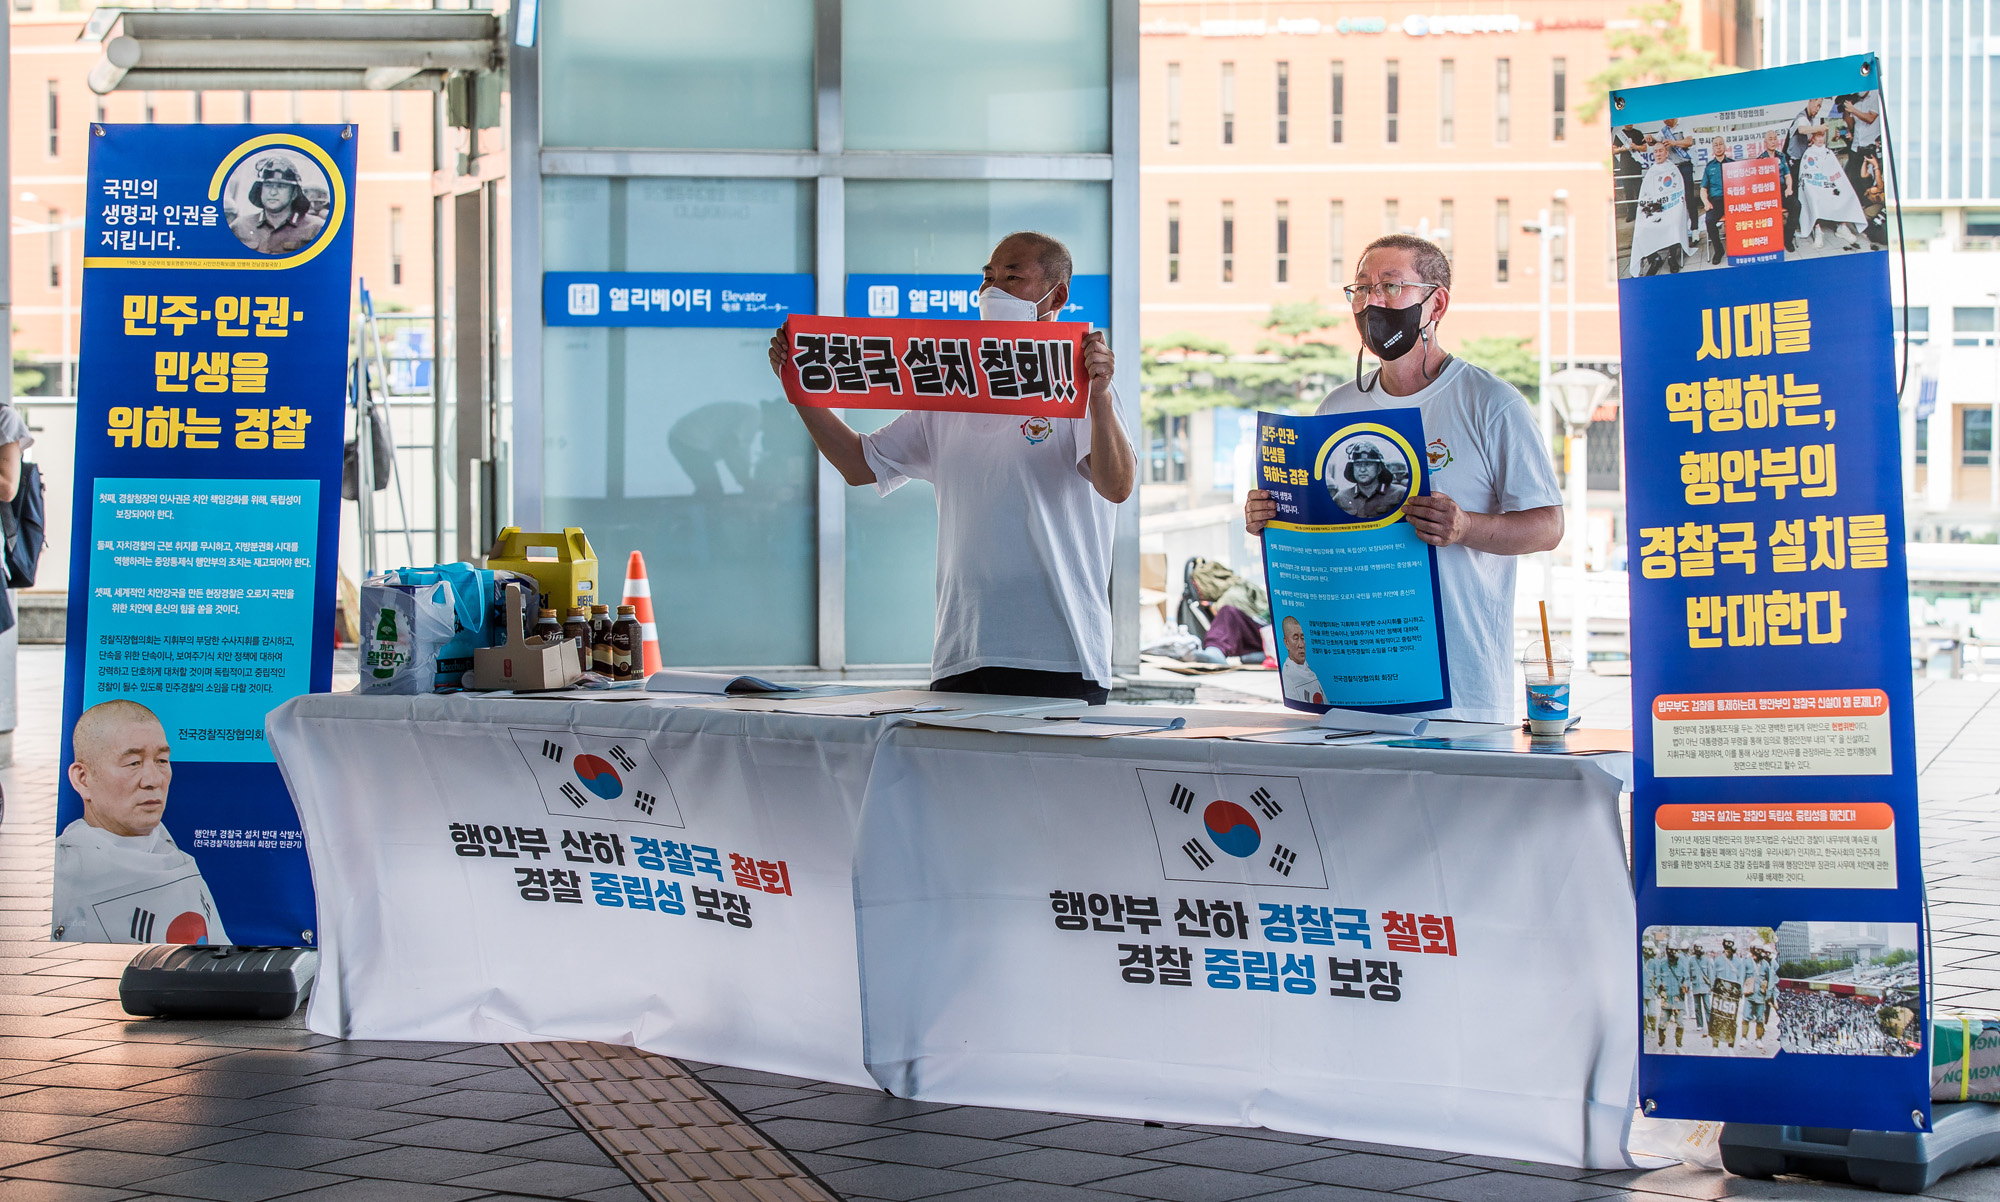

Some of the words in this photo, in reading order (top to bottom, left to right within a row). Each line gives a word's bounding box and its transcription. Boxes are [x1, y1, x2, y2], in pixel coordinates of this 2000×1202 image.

[103, 179, 157, 199] 국민의
[101, 205, 157, 226] 생명과
[164, 205, 219, 227] 인권을
[101, 231, 181, 251] 지킵니다.
[609, 288, 711, 312] 엘리베이터
[722, 290, 767, 302] Elevator
[908, 289, 980, 313] 엘리베
[123, 295, 303, 337] 민주·인권·
[1696, 299, 1811, 361] 시대를
[155, 352, 269, 393] 민생을
[794, 333, 903, 395] 경찰국
[902, 337, 979, 397] 설치
[979, 337, 1078, 404] 철회!!
[1665, 374, 1836, 433] 역행하는,
[107, 407, 222, 449] 위하는
[235, 407, 311, 449] 경찰
[1262, 446, 1285, 463] 민생을
[1263, 466, 1288, 483] 위하는
[1289, 469, 1308, 485] 경찰
[1679, 444, 1837, 505] 행안부의
[118, 493, 158, 504] 경찰청장의
[159, 494, 190, 504] 인사권은
[192, 494, 208, 504] 치안
[210, 494, 249, 505] 책임강화를
[250, 495, 268, 505] 위해,
[270, 495, 301, 506] 독립성이
[115, 509, 155, 520] 보장되어야
[156, 510, 174, 520] 한다.
[116, 540, 155, 551] 자치경찰의
[157, 541, 173, 551] 근본
[175, 541, 198, 551] 취지를
[200, 541, 233, 552] 무시하고,
[234, 542, 274, 552] 지방분권화
[274, 542, 298, 552] 시대를
[1640, 522, 1757, 579] 경찰국
[1769, 514, 1889, 572] 설치를
[113, 556, 152, 567] 역행하려는
[154, 557, 194, 567] 중앙통제식
[195, 557, 226, 568] 행안부의
[228, 557, 252, 568] 조치는
[253, 557, 292, 568] 재고되어야
[294, 557, 312, 568] 한다.
[114, 588, 145, 598] 세계적인
[147, 588, 186, 599] 치안강국을
[188, 588, 204, 598] 만든
[205, 588, 244, 599] 현장경찰은
[245, 589, 270, 599] 오로지
[271, 588, 294, 599] 국민을
[1687, 590, 1847, 648] 반대한다
[99, 634, 161, 646] 경찰직장협의회는
[163, 635, 194, 645] 지휘부의
[196, 635, 220, 646] 부당한
[221, 636, 260, 646] 수사지휘를
[262, 636, 294, 646] 감시하고,
[98, 650, 122, 660] 단속을
[124, 651, 140, 661] 위한
[141, 651, 174, 662] 단속이나,
[176, 651, 215, 662] 보여주기식
[216, 652, 232, 661] 치안
[234, 651, 258, 662] 정책에
[259, 651, 282, 662] 대하여
[367, 651, 404, 666] 활명수
[98, 666, 129, 677] 강력하고
[130, 667, 162, 677] 단호하게
[163, 667, 187, 677] 대처할
[189, 667, 212, 677] 것이며
[214, 667, 252, 678] 독립적이고
[254, 667, 286, 678] 중립적인
[97, 682, 120, 692] 경찰이
[122, 682, 138, 692] 될수
[140, 682, 163, 693] 있도록
[165, 682, 204, 693] 민주경찰의
[205, 683, 229, 693] 소임을
[230, 683, 247, 693] 다할
[248, 683, 274, 693] 것이다.
[1657, 700, 1690, 713] 법무부도
[1690, 699, 1715, 712] 검찰을
[1716, 699, 1758, 711] 통제하는데,
[1758, 698, 1791, 710] 행안부의
[1792, 697, 1816, 710] 경찰국
[1817, 696, 1841, 709] 신설이
[1842, 696, 1852, 708] 왜
[178, 728, 264, 741] 전국경찰직장협의회
[1690, 810, 1715, 822] 경찰국
[1717, 810, 1741, 822] 설치는
[1742, 810, 1766, 822] 경찰의
[1768, 810, 1794, 822] 독립성,
[1795, 809, 1828, 822] 중립성을
[1829, 809, 1856, 821] 해친다!
[449, 822, 551, 860] 행안부
[560, 829, 625, 866] 산하
[630, 836, 724, 882] 경찰국
[729, 852, 792, 896] 철회
[514, 867, 583, 904] 경찰
[590, 871, 686, 916] 중립성
[692, 885, 752, 928] 보장
[1049, 889, 1162, 935] 행안부
[1173, 899, 1249, 940] 산하
[1259, 902, 1372, 949] 경찰국
[1382, 910, 1458, 957] 철회
[1117, 943, 1194, 987] 경찰
[1204, 947, 1316, 996] 중립성
[1328, 957, 1402, 1002] 보장
